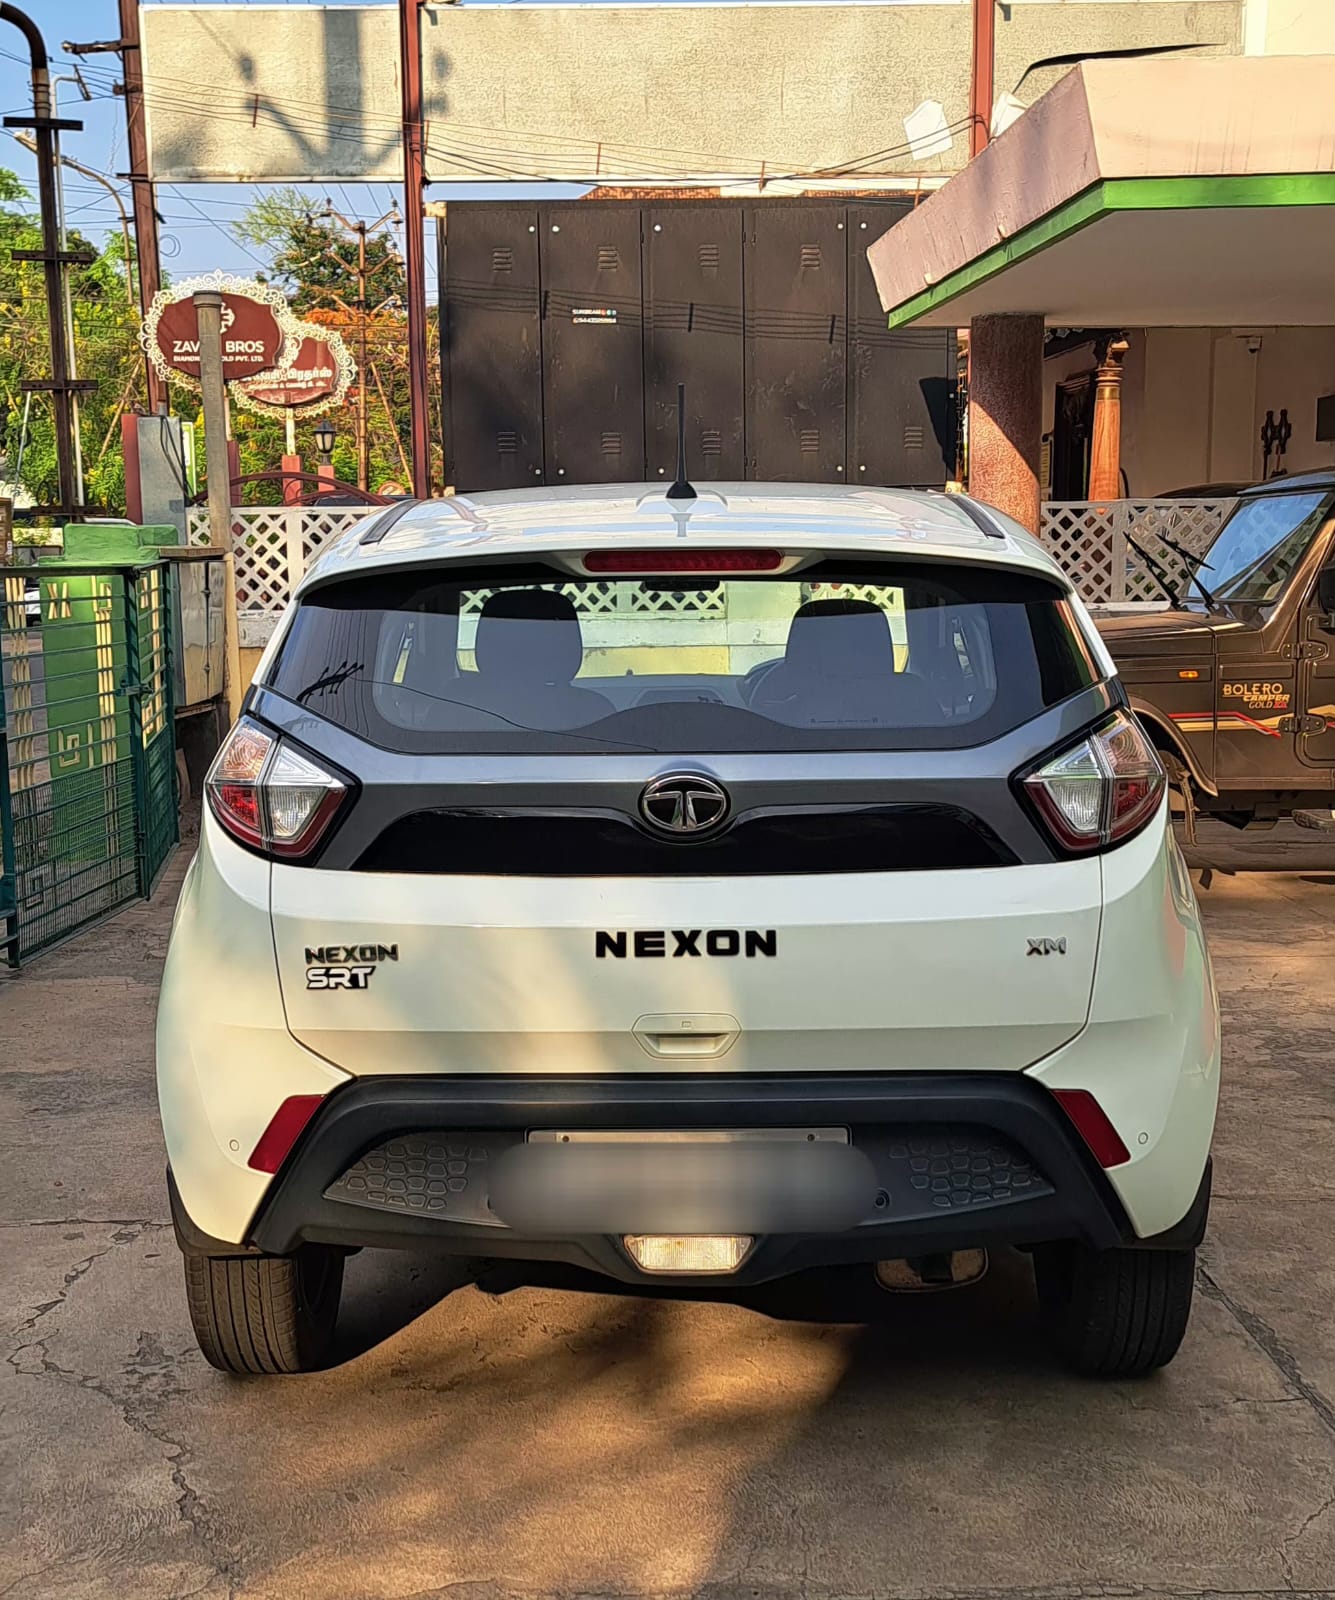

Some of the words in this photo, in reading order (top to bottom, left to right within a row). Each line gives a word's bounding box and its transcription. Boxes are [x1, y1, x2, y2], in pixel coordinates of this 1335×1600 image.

[225, 340, 265, 353] BROS
[1222, 683, 1283, 695] BOLERO
[1243, 694, 1291, 703] CAMPER
[1249, 701, 1273, 709] GOLD
[596, 930, 777, 958] NEXON
[1025, 936, 1067, 956] XM
[304, 943, 399, 965] NEXON
[306, 965, 376, 989] SRT
